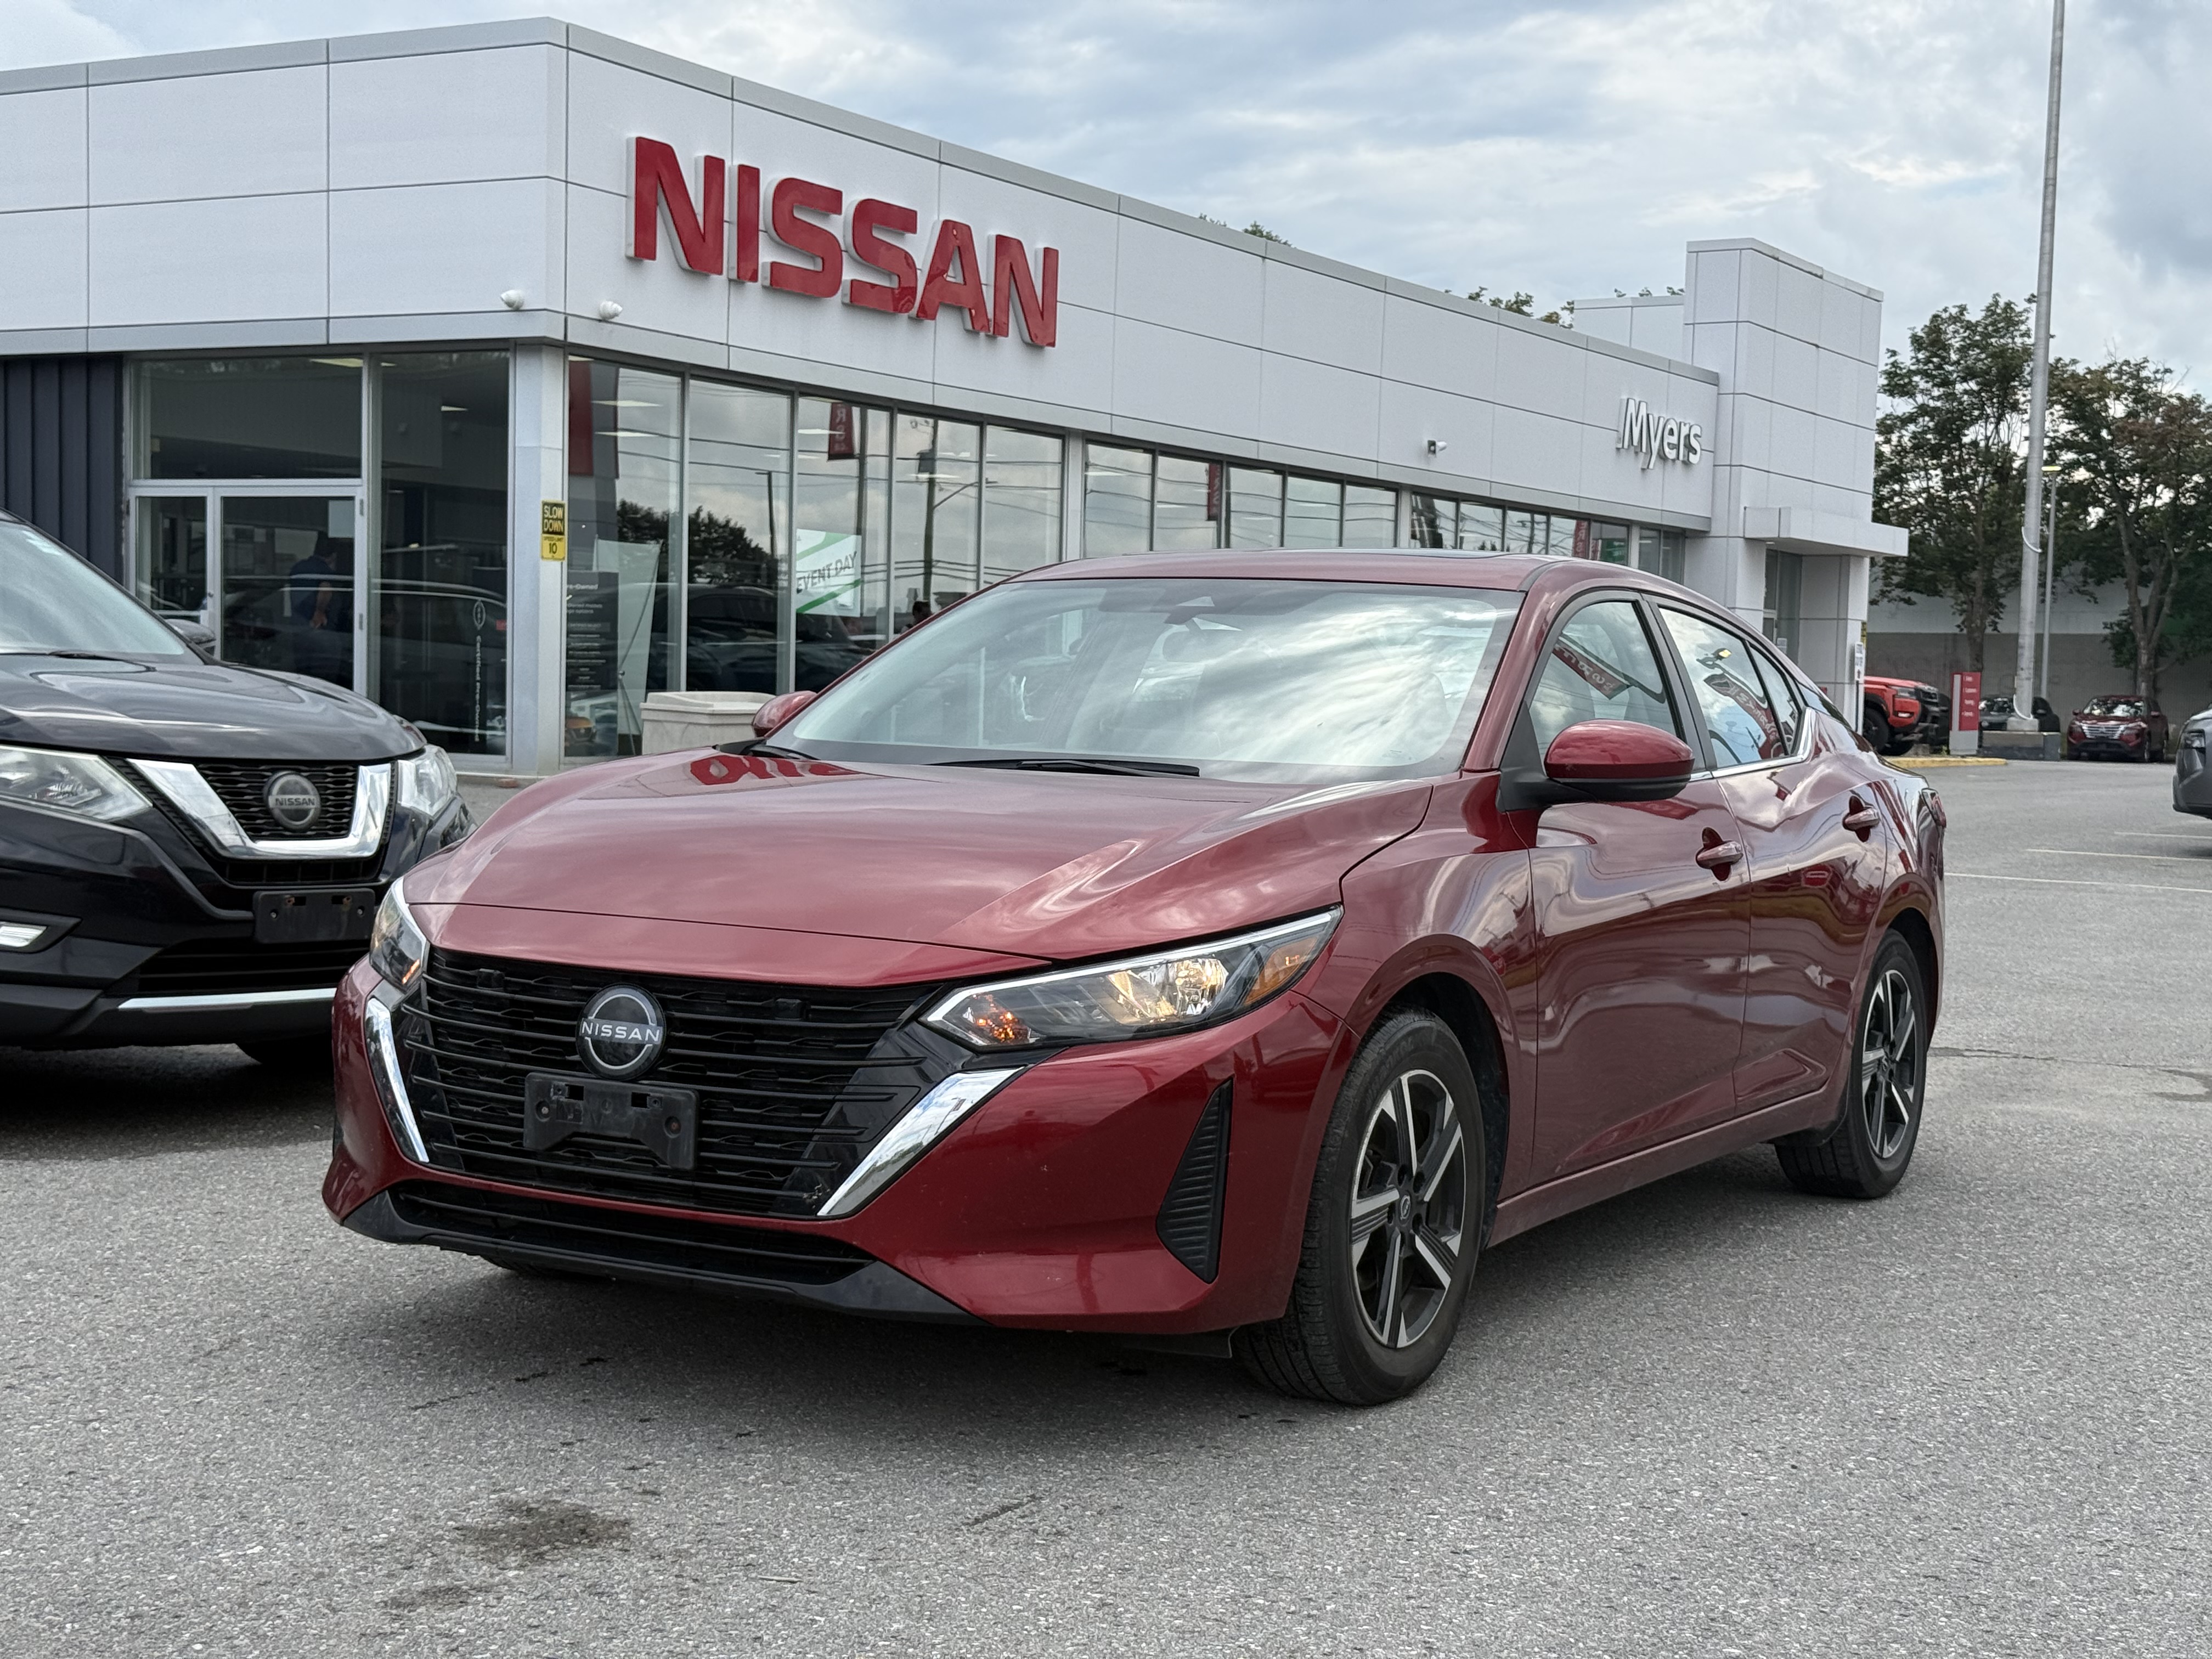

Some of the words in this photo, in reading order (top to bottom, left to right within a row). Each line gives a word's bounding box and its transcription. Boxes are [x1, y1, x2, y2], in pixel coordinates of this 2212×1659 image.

[627, 136, 1059, 348] NISSAN
[1618, 397, 1702, 470] Myers
[544, 505, 563, 519] SLOW
[544, 519, 563, 532] DOWN
[549, 542, 557, 554] 10
[797, 561, 833, 594] EVENT
[835, 550, 857, 576] DAY
[275, 798, 315, 806] NISSAN
[582, 1021, 660, 1042] NISSAN
